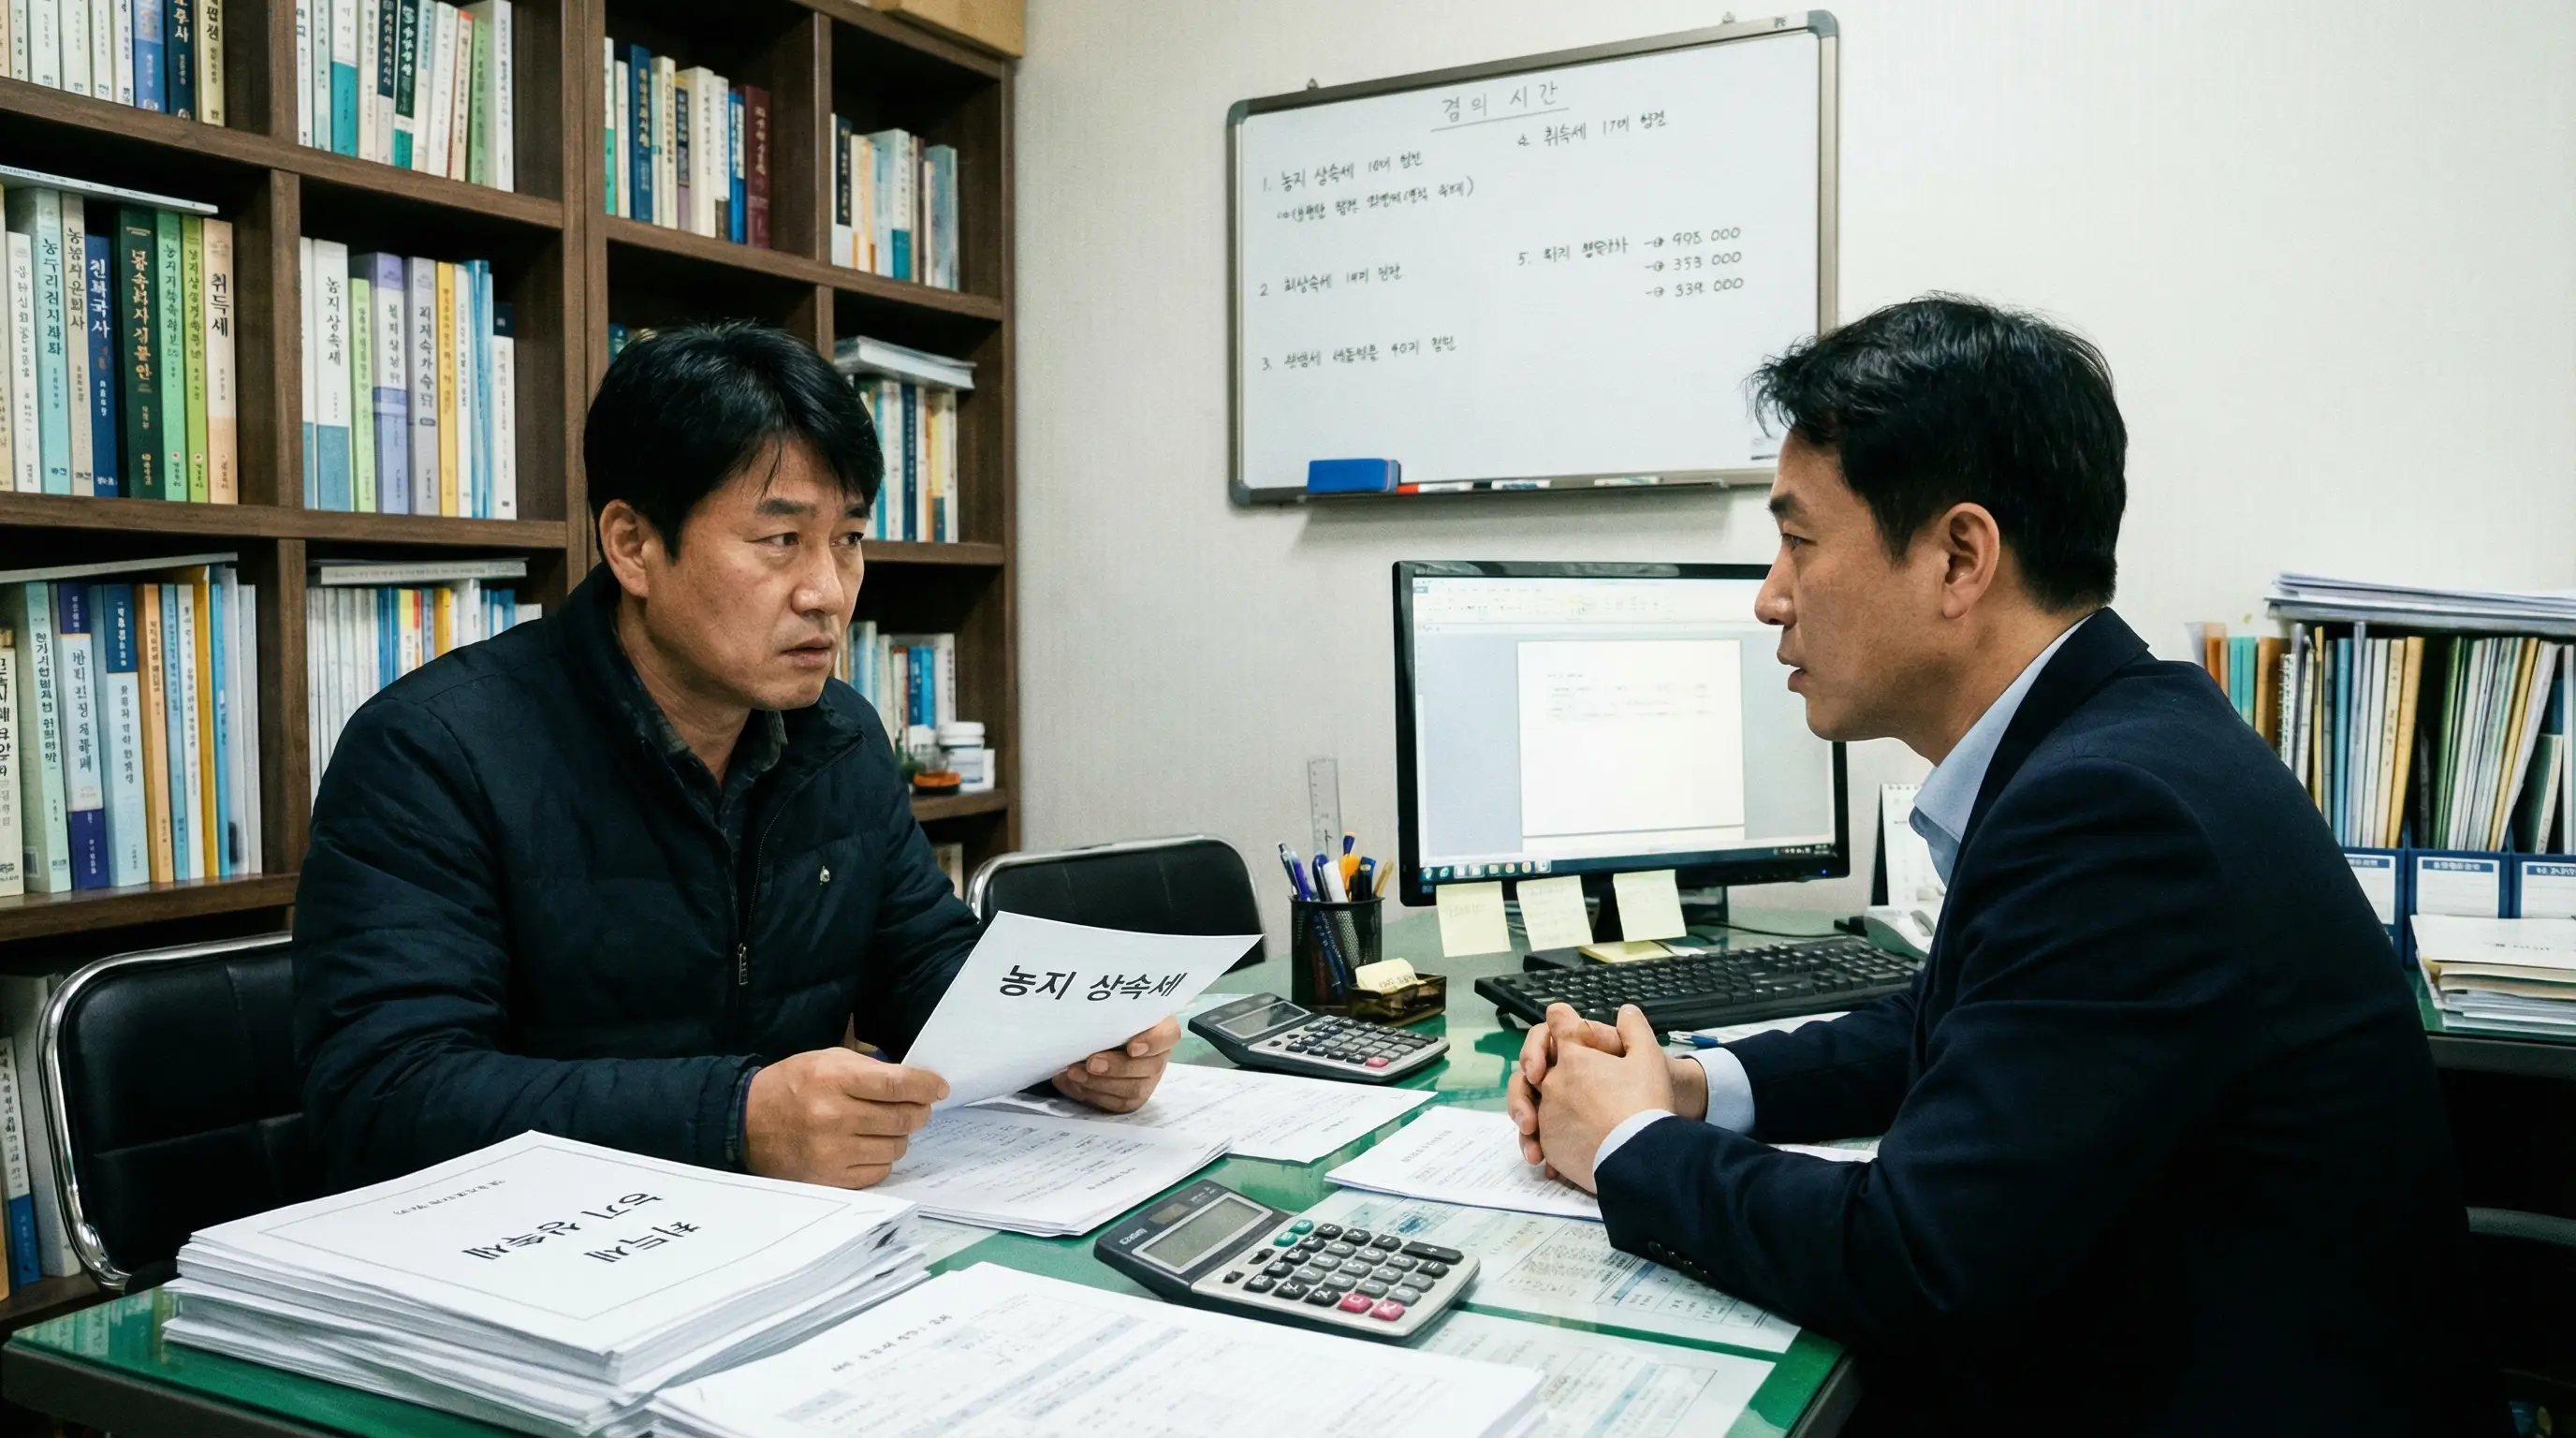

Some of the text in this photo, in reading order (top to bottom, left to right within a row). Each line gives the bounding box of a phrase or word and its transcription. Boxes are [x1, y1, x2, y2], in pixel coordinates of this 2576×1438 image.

[1710, 227, 1742, 242] 000
[1711, 250, 1743, 266] 000
[1713, 277, 1745, 293] 000
[211, 273, 230, 338] 취득세
[999, 964, 1188, 1002] 농지 상속세
